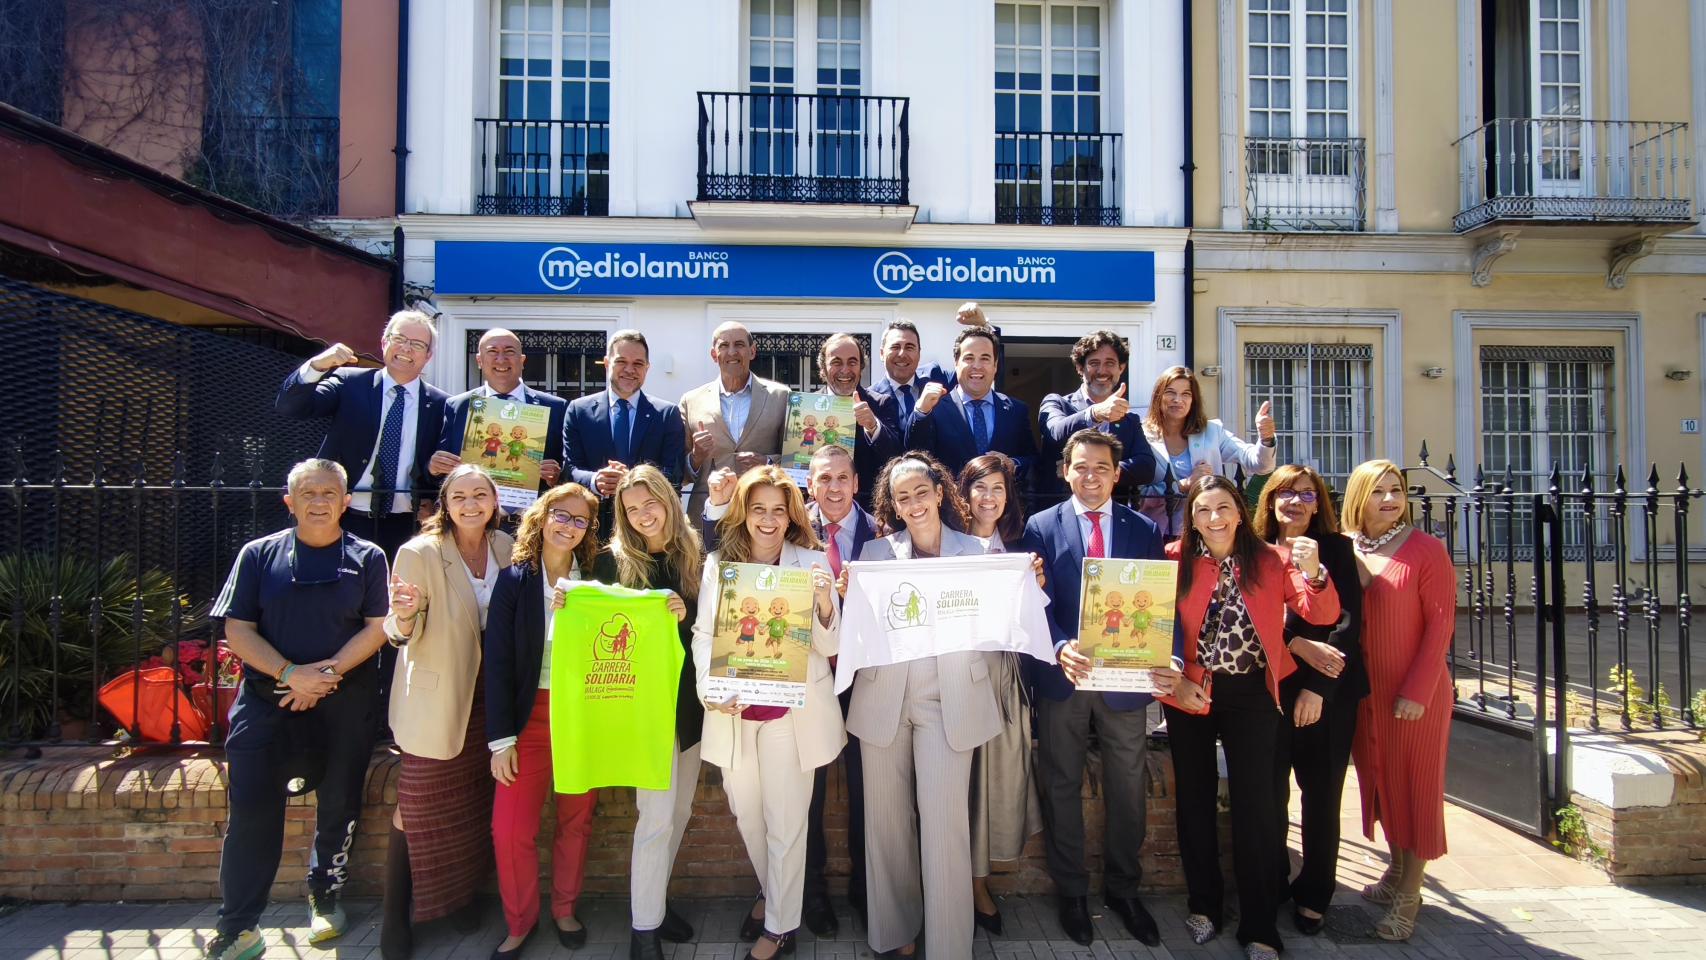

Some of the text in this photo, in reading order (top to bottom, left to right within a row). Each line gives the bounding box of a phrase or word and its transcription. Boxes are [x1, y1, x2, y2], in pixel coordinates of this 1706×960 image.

[689, 251, 729, 261] BANCO
[1017, 256, 1056, 266] BANCO
[547, 252, 729, 279] mediolanum
[882, 257, 1056, 284] mediolanum
[1160, 337, 1172, 349] 12
[1684, 420, 1696, 432] 10
[940, 590, 973, 600] CARRERA
[936, 598, 979, 608] SOLIDARIA
[591, 661, 631, 673] CARRERA
[584, 673, 636, 685] SOLIDARIA
